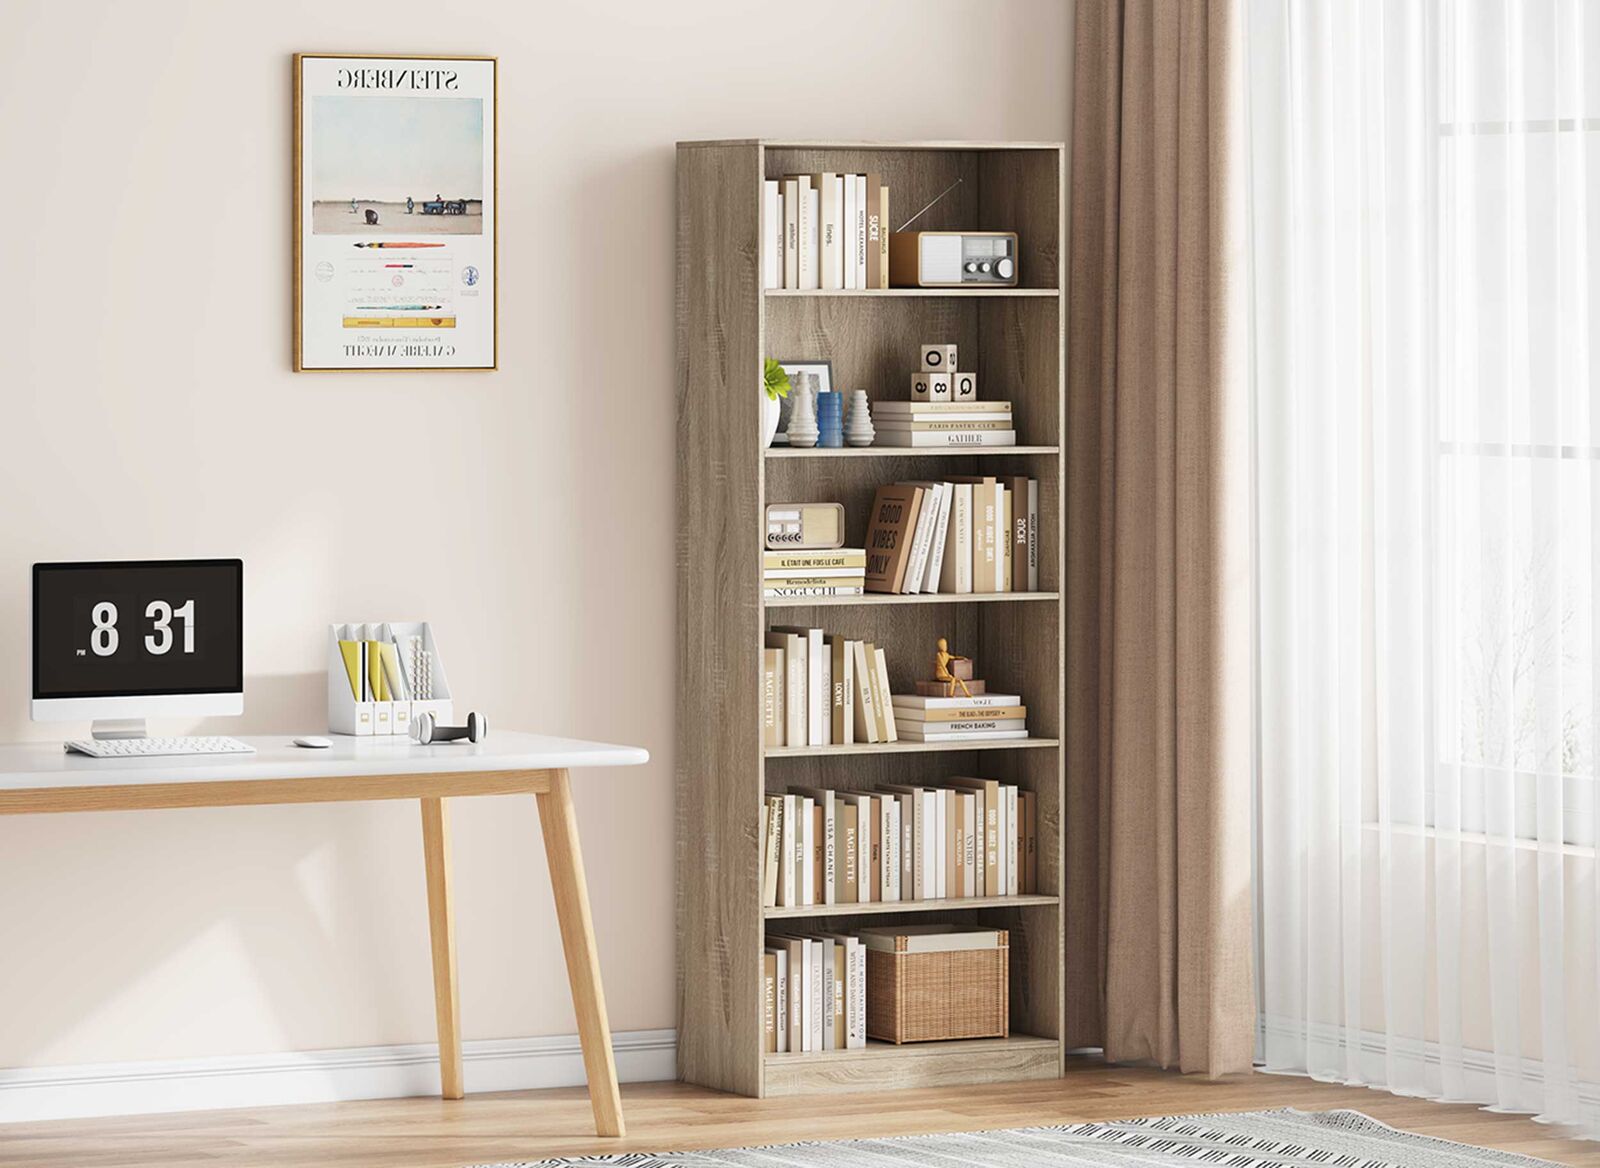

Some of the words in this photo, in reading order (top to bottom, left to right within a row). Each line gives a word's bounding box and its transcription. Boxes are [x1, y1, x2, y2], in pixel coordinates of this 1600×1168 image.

[869, 215, 879, 241] SUCRE
[879, 503, 902, 524] GOOD
[872, 528, 898, 550] VIBES
[868, 554, 891, 575] ONLY
[773, 587, 836, 597] NOGUCHI
[90, 601, 119, 657] 8
[144, 600, 195, 656] 31
[765, 671, 774, 728] BAGUETTE
[835, 682, 843, 707] LOEWE
[847, 828, 856, 884] BAGUETTE
[765, 977, 774, 1034] BAGUETTE
[859, 1012, 865, 1021] IS
